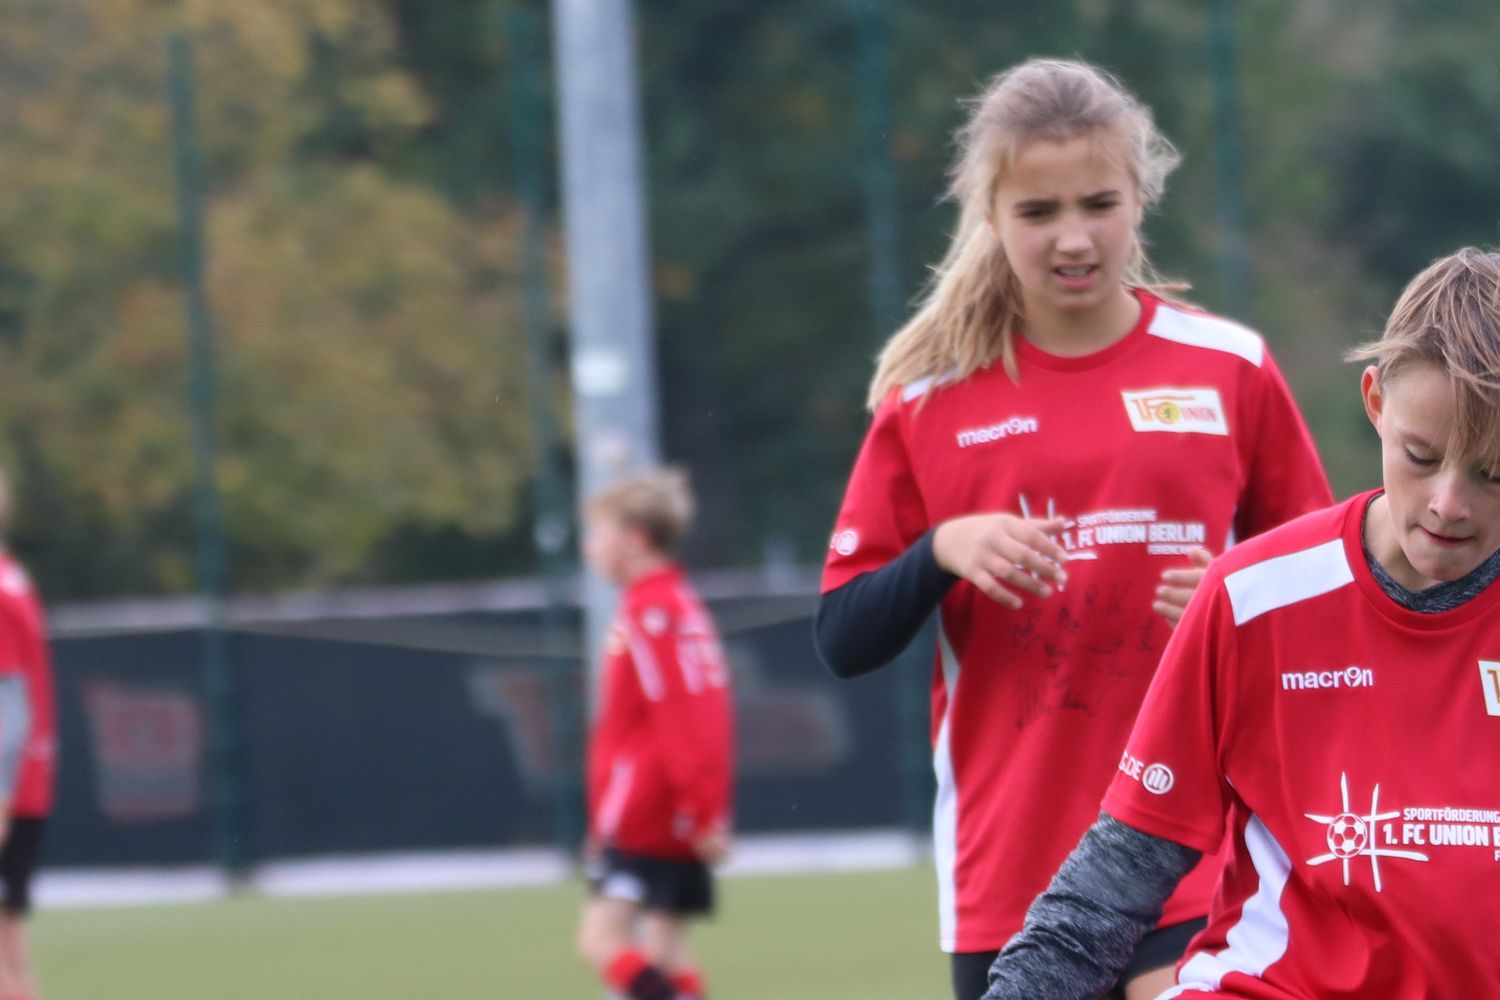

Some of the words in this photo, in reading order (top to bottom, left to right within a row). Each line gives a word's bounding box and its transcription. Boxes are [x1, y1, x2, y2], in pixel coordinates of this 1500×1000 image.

[956, 416, 1039, 448] macron
[1095, 524, 1147, 544] UNION
[1148, 522, 1206, 544] BERLIN
[1281, 666, 1374, 691] macron
[1382, 823, 1399, 845] 1.
[1402, 823, 1426, 845] FC
[1428, 824, 1490, 847] UNION
